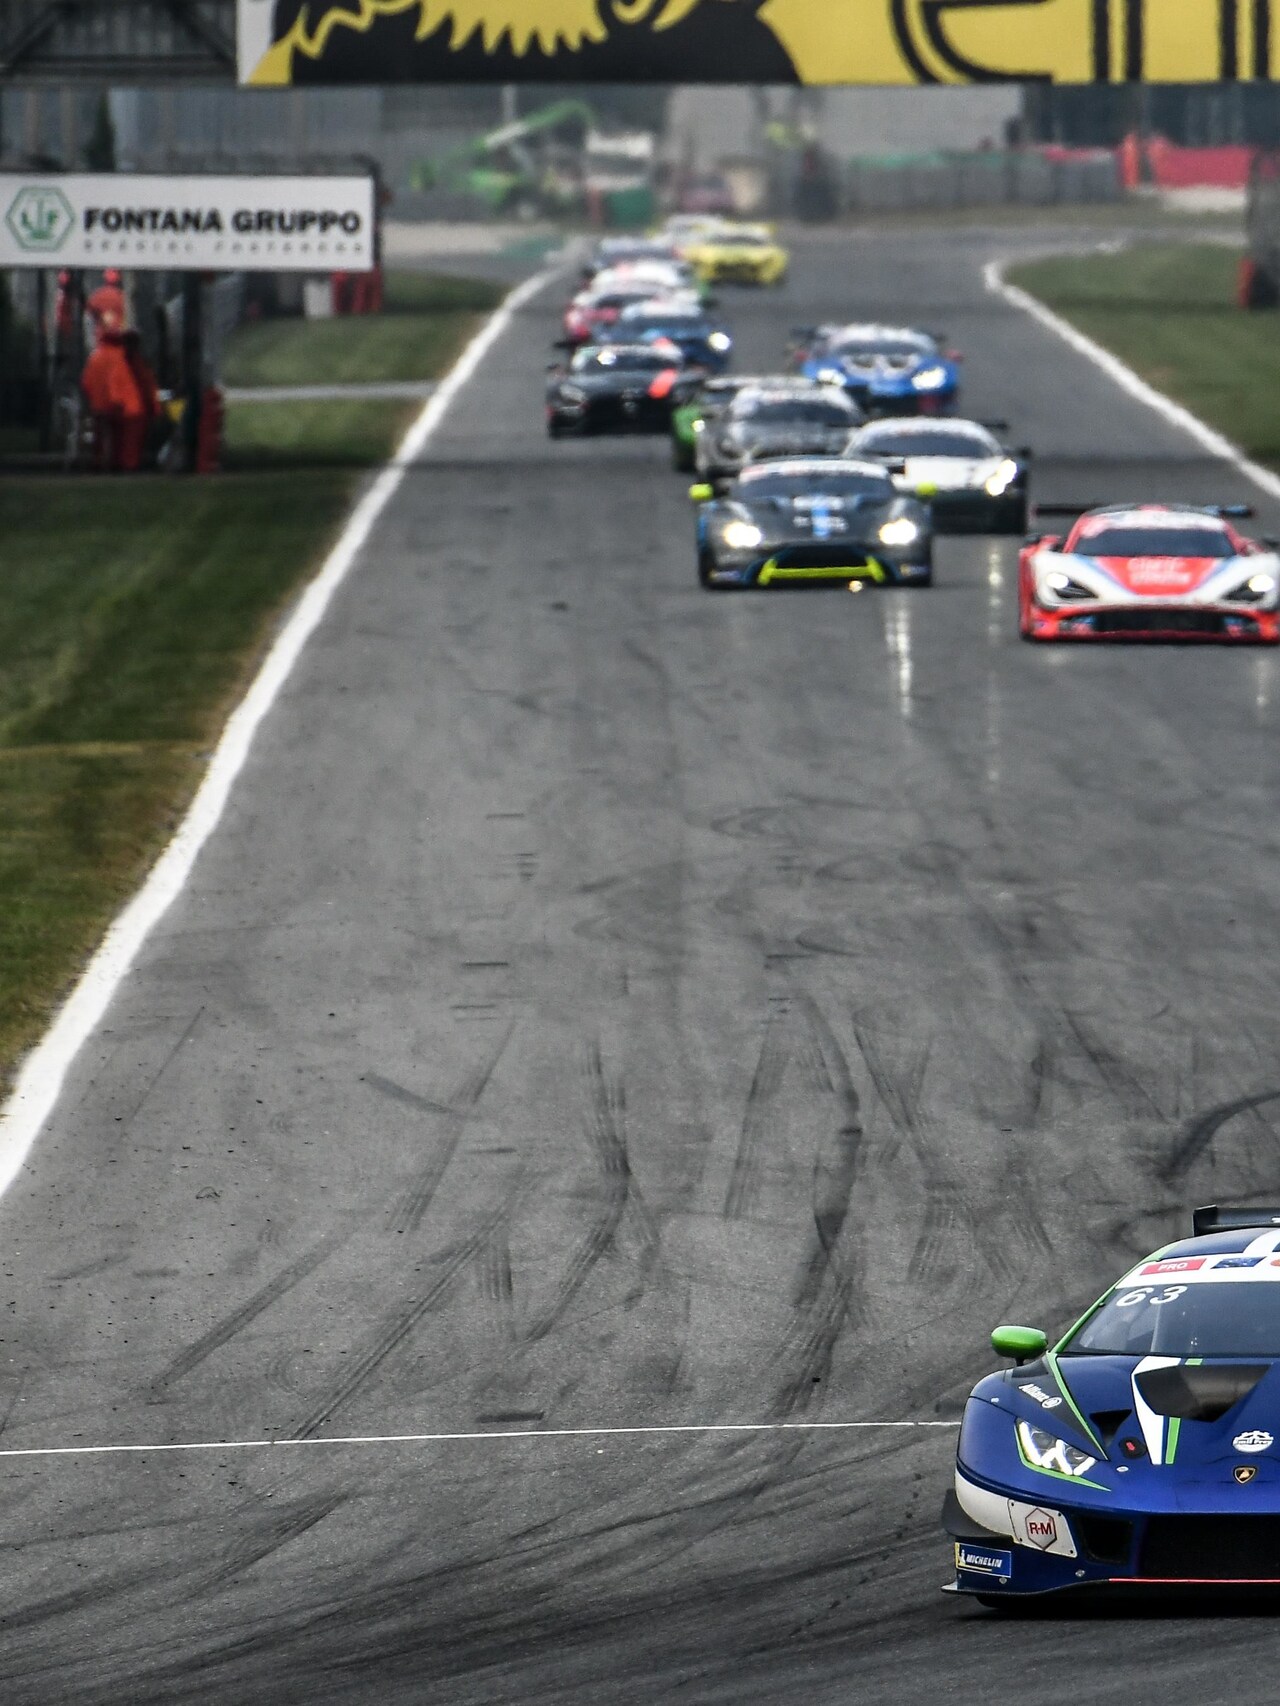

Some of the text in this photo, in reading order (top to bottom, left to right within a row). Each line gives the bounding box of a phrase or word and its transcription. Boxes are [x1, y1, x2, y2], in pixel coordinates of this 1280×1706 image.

[84, 207, 362, 235] FONTANA GRUPPO
[1157, 1261, 1189, 1272] PRO
[1115, 1285, 1188, 1307] 63
[1028, 1521, 1053, 1536] R-M
[966, 1554, 1003, 1568] MICHELIN
